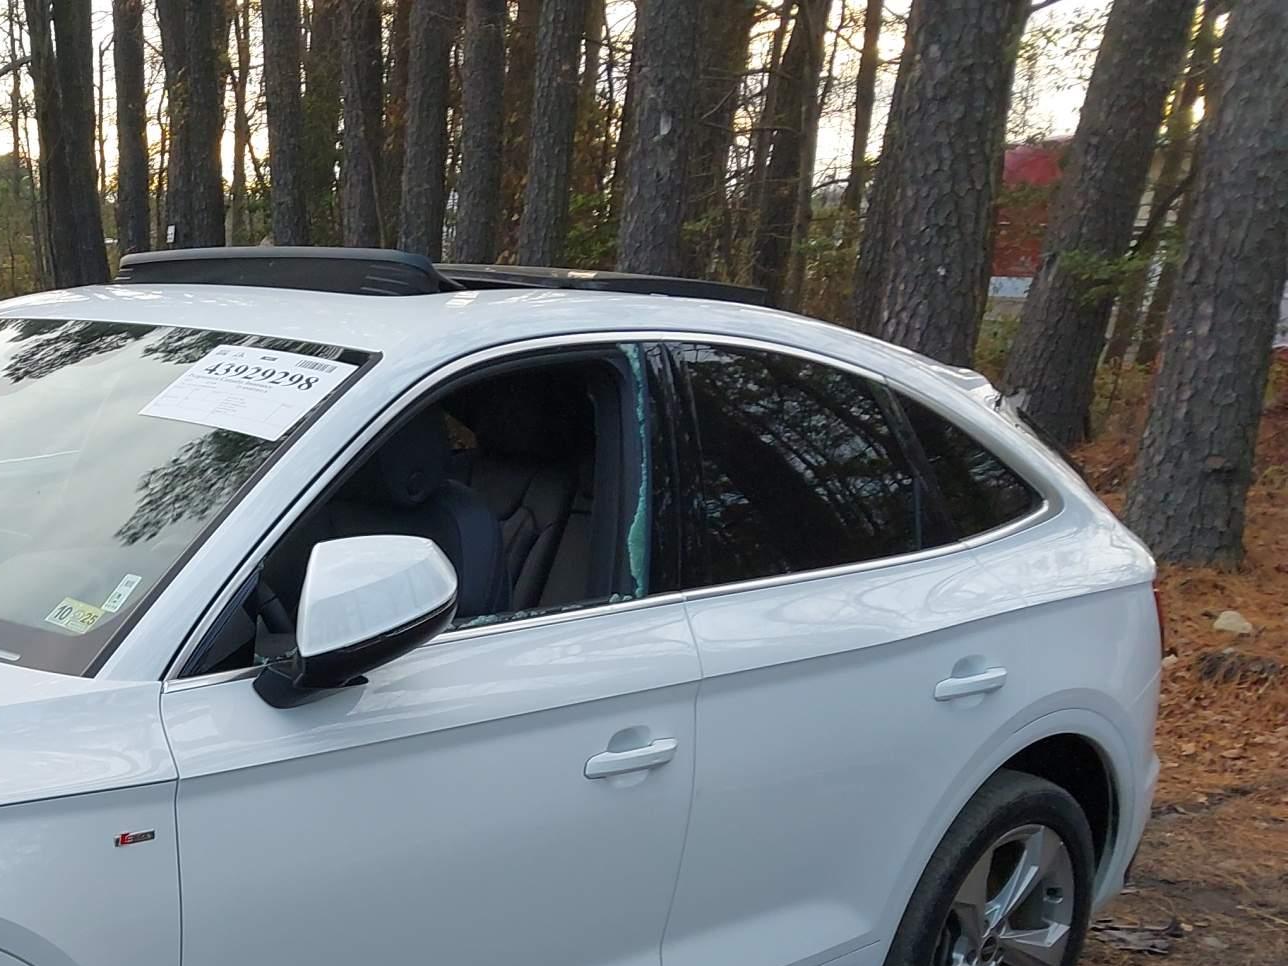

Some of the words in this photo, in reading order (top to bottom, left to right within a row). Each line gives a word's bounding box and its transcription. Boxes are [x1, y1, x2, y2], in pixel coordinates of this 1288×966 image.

[204, 361, 320, 392] 43929298
[53, 604, 73, 621] 10
[79, 612, 99, 625] 25
